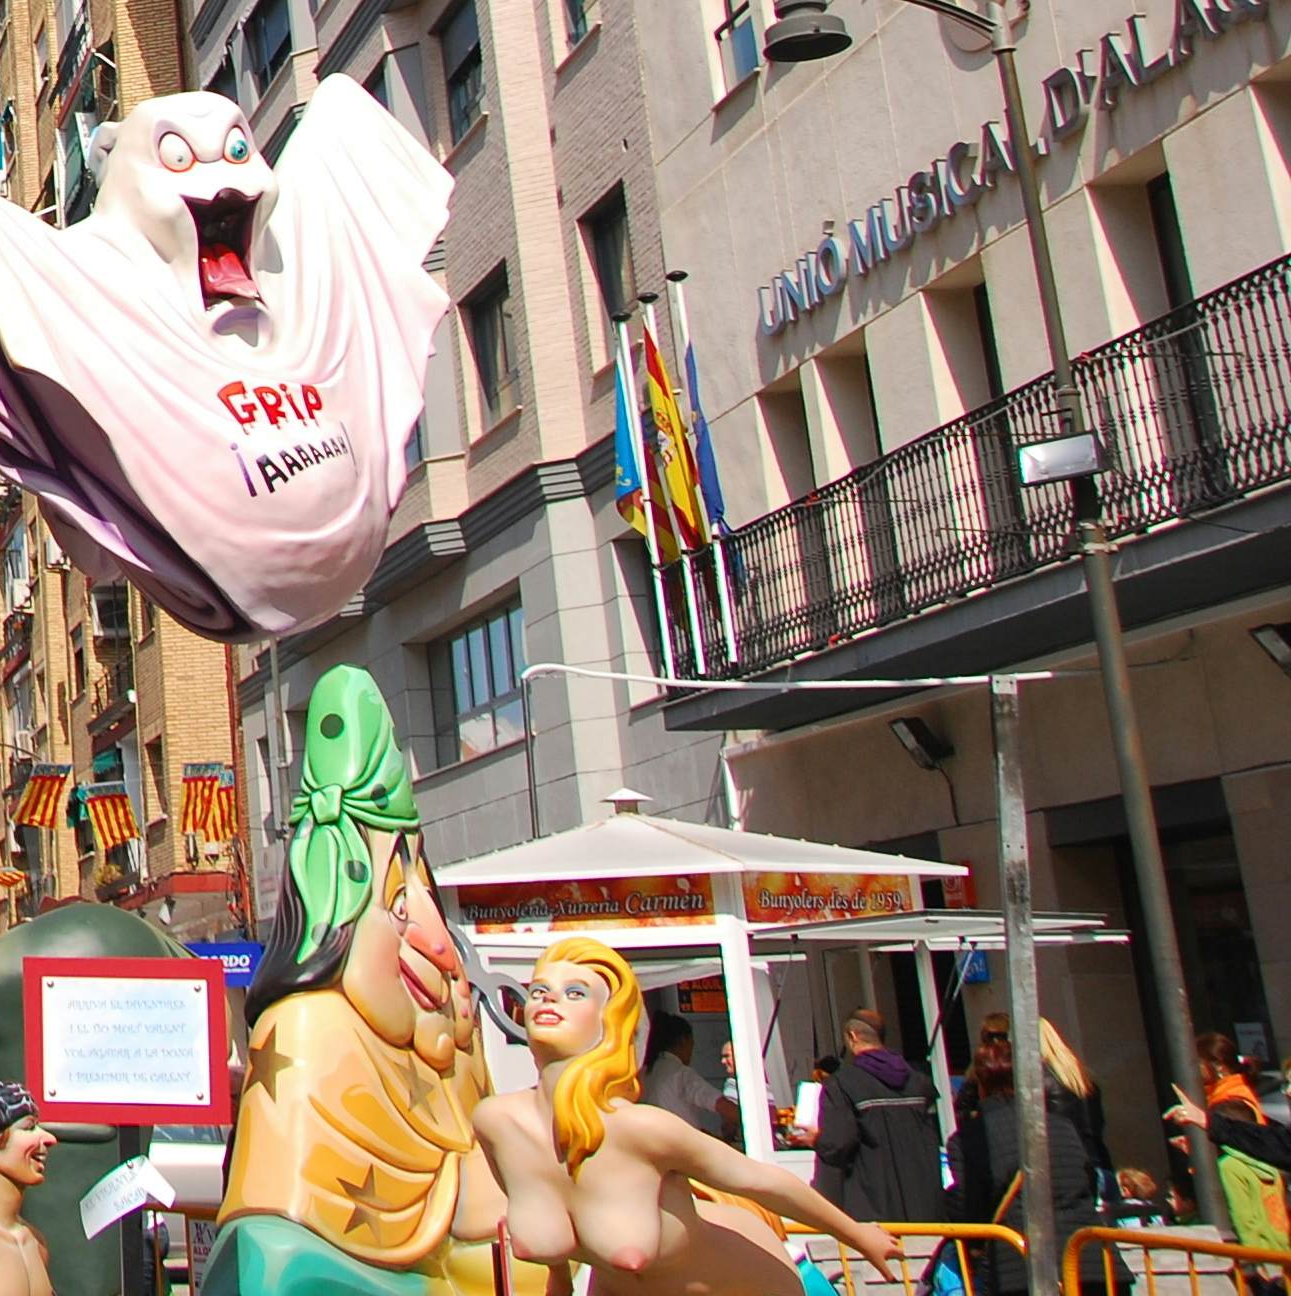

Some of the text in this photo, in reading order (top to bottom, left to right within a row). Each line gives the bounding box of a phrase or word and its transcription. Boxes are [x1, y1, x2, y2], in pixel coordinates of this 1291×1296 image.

[756, 220, 849, 337] UNIÓ
[760, 888, 828, 916] Bunyolers
[851, 888, 867, 911] de
[870, 890, 903, 912] 1959
